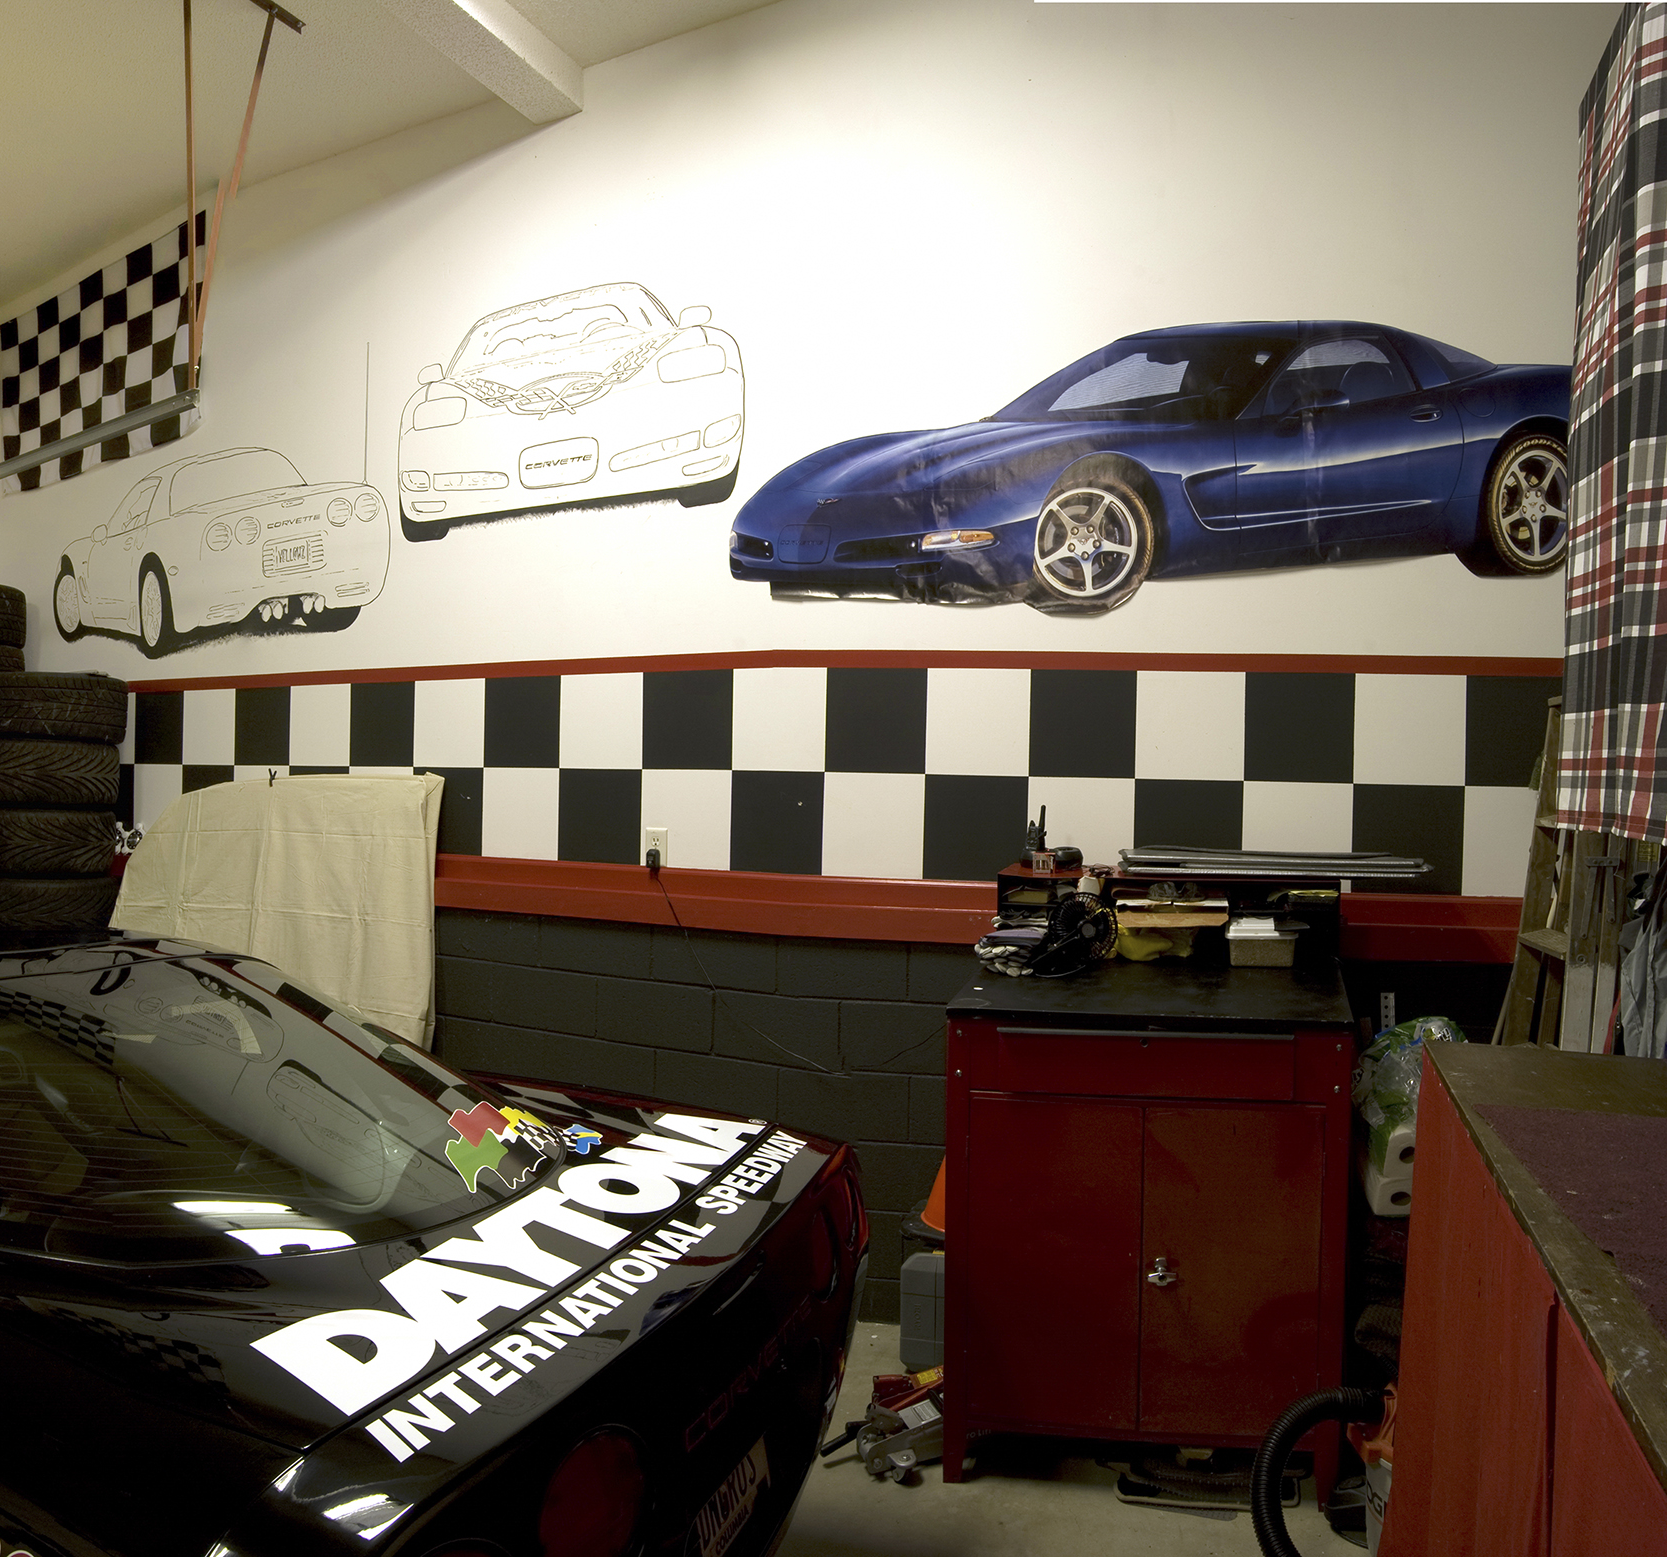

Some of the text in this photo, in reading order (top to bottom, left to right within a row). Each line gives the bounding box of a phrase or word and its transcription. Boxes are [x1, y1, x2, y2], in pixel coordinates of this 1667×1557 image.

[524, 453, 593, 472] CORVETTE
[266, 513, 321, 531] CORVETTE
[249, 1113, 765, 1417] DAYTONA
[365, 1129, 808, 1464] INTERNATIONAL SPEEDWAY
[715, 1504, 749, 1556] COLUMBIA
